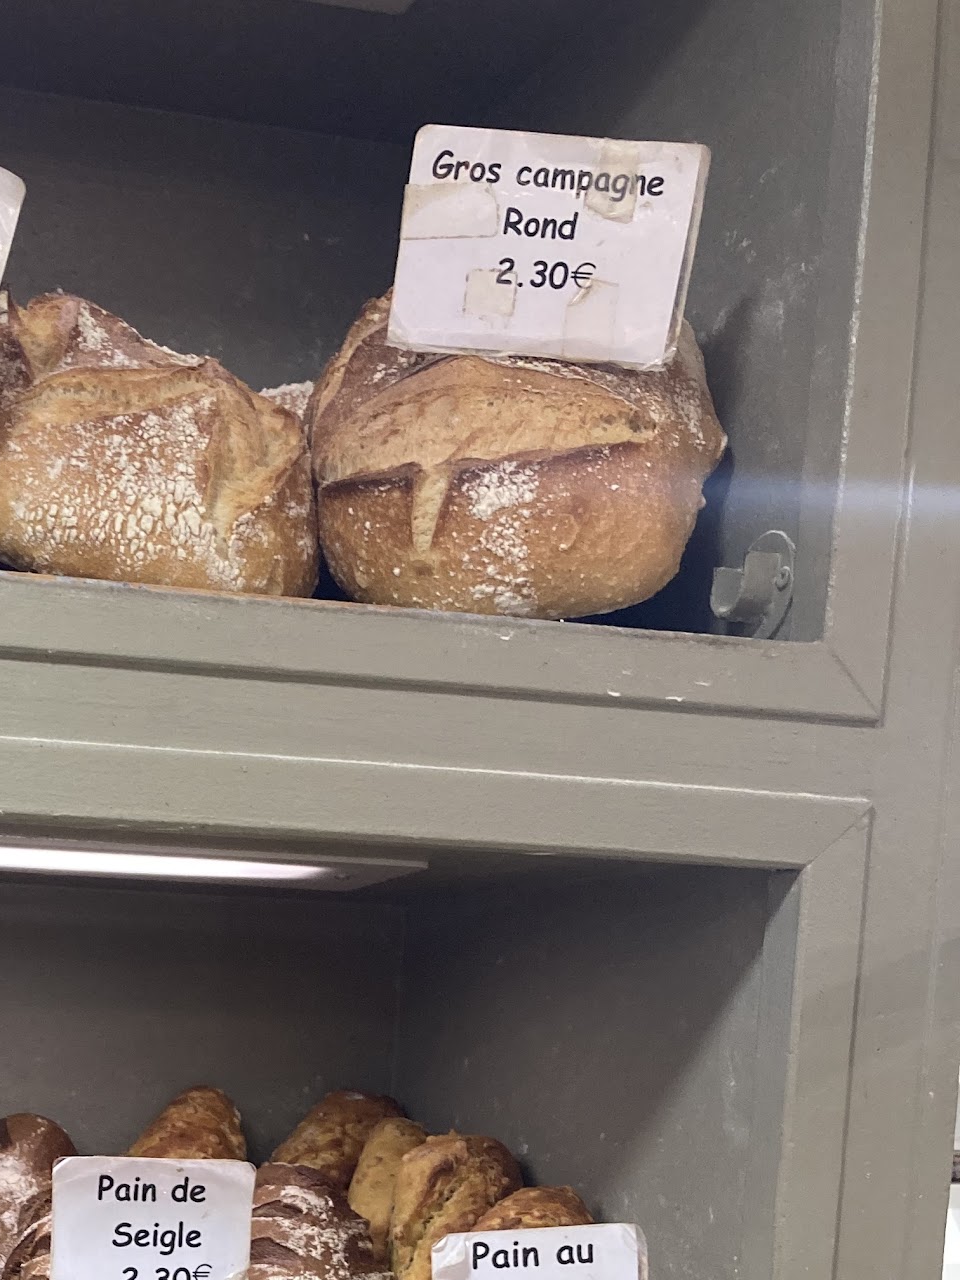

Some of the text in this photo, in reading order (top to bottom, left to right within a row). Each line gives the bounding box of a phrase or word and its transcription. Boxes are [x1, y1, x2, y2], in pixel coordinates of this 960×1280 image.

[432, 150, 664, 201] Gros campagne
[503, 207, 579, 240] Rond
[496, 257, 596, 290] 2.30€
[97, 1174, 206, 1203] Pain de
[112, 1221, 202, 1255] Seigle
[472, 1241, 593, 1270] Pain au
